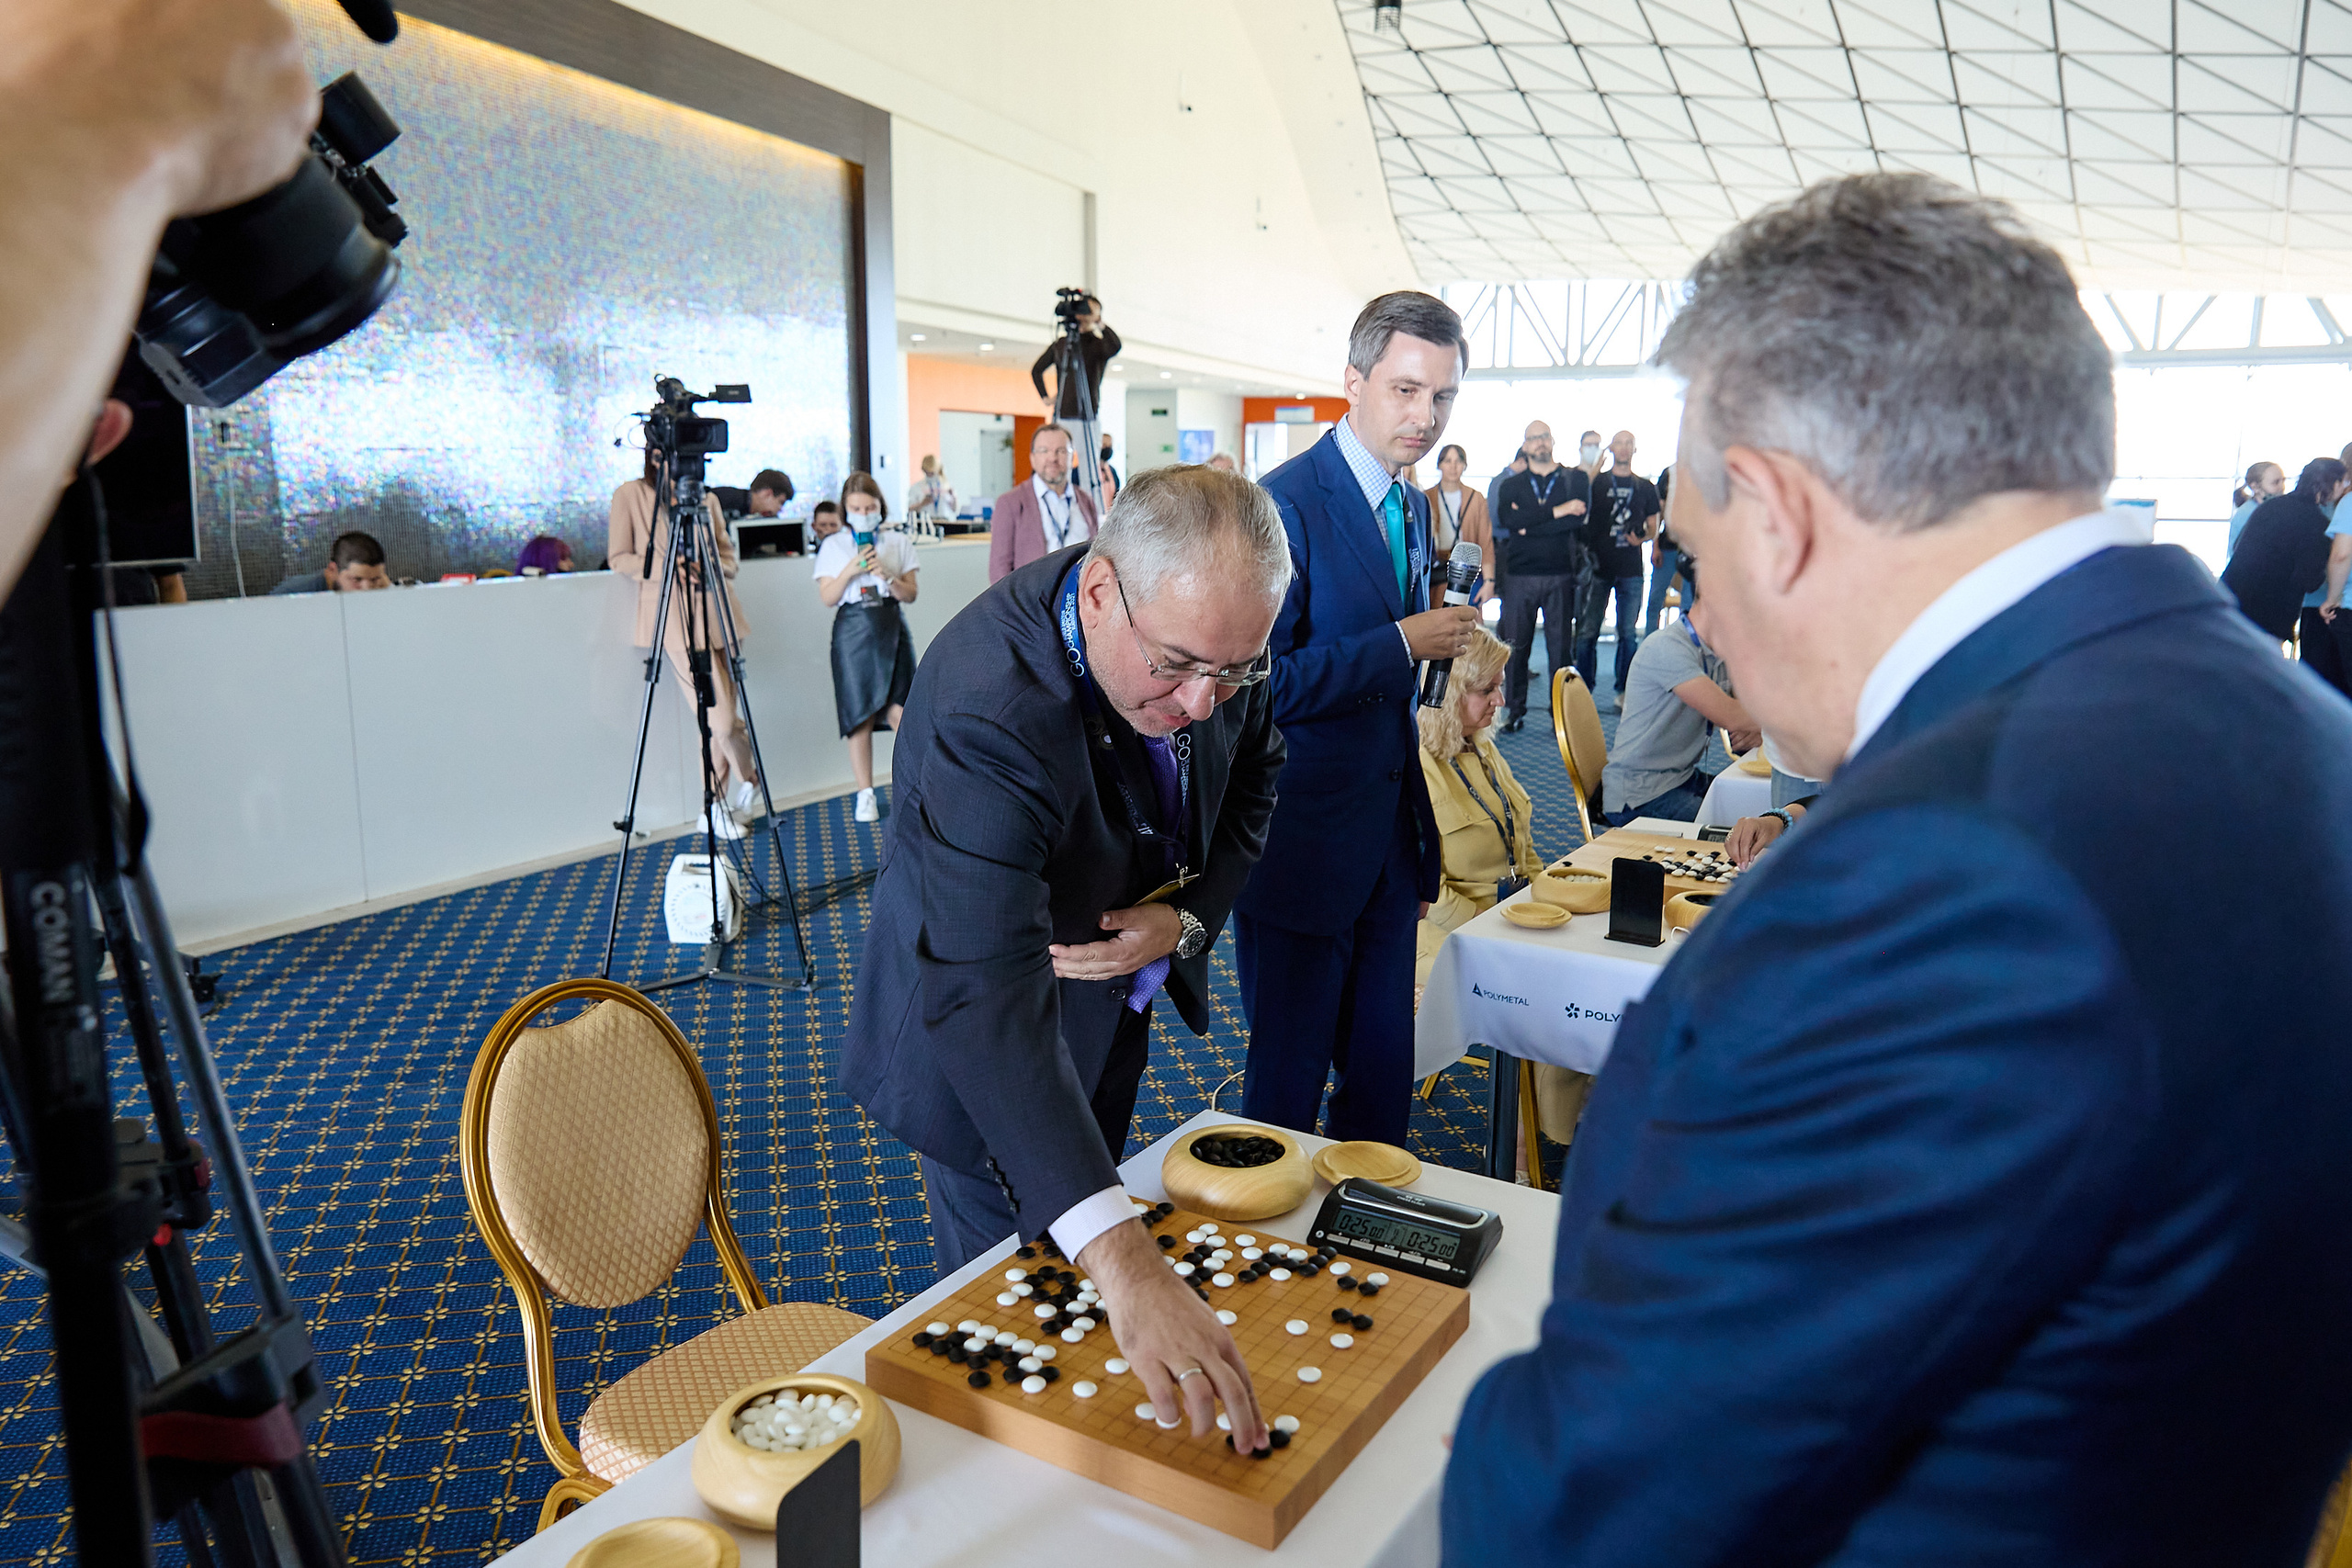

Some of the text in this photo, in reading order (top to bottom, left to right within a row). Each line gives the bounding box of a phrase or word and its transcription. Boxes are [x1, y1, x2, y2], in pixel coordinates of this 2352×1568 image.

[1065, 592, 1075, 649] CHAMPIONSHIP
[1067, 648, 1085, 677] GO
[1177, 733, 1191, 761] GO
[1483, 989, 1530, 1007] POLYMETAL
